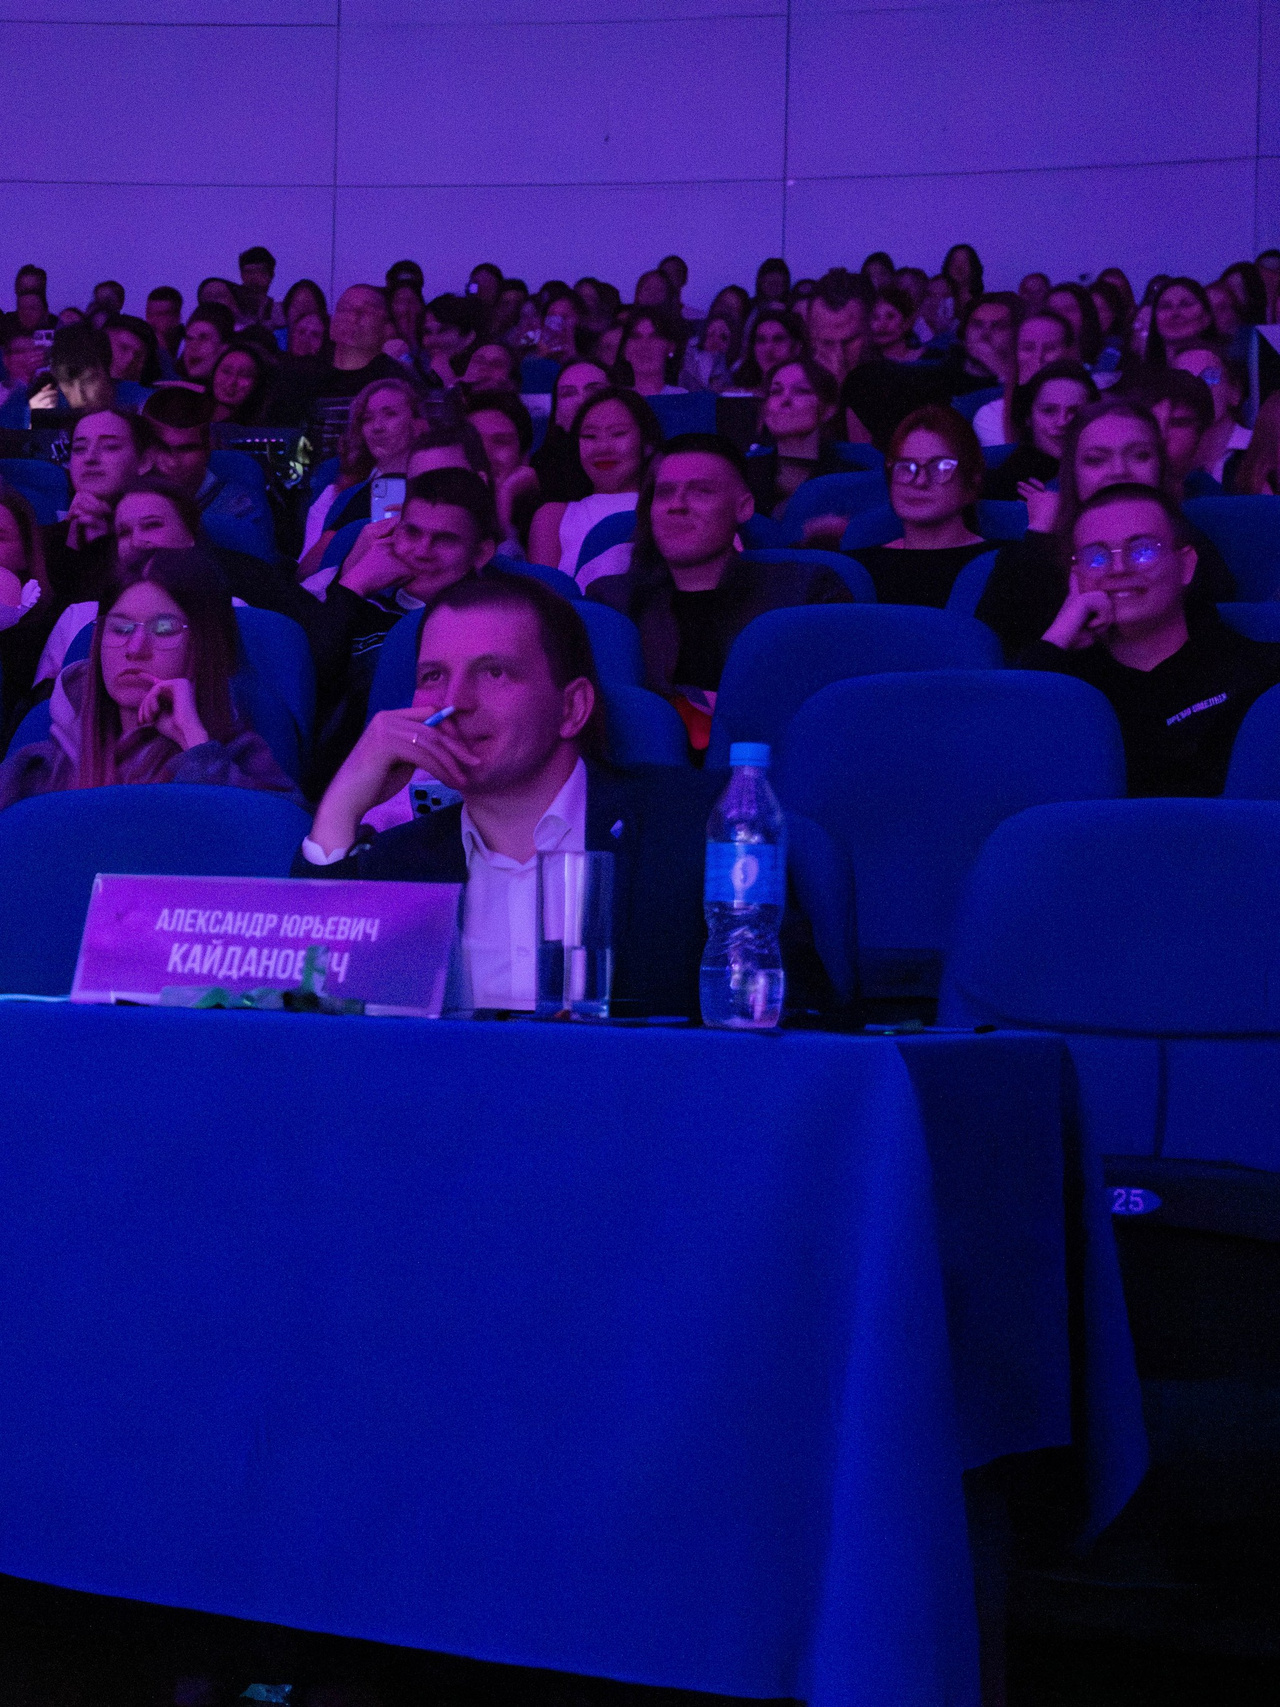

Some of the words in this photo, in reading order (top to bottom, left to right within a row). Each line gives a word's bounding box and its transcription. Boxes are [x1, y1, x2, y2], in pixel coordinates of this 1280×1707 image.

[155, 908, 278, 939] АЛЕКСАНДР
[280, 913, 380, 942] ЮРЬЕВИЧ
[167, 939, 350, 983] КАЙДАНОВЧ
[1112, 1188, 1144, 1210] 25
